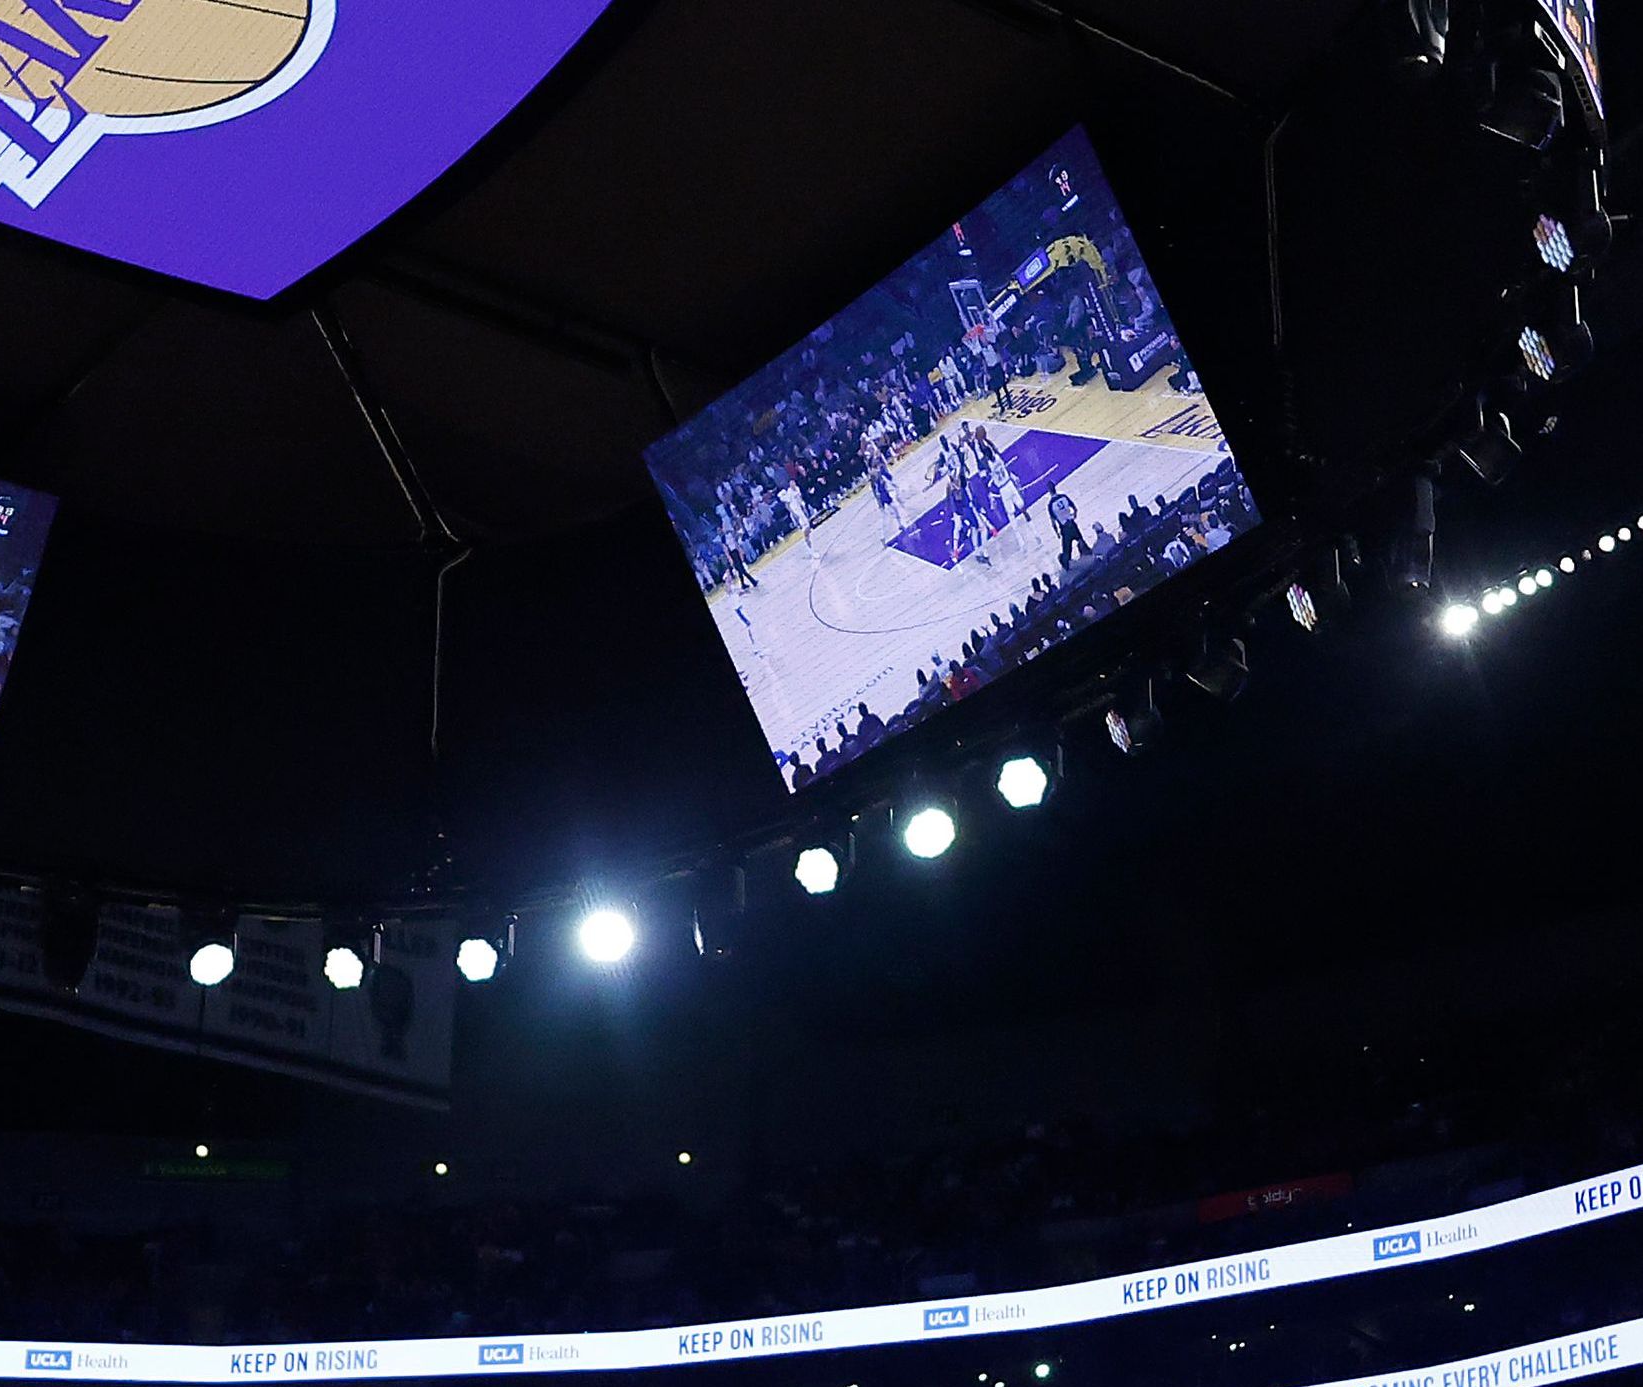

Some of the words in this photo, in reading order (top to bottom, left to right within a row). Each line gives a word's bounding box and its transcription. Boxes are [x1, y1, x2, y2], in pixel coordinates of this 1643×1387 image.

[1575, 1182, 1622, 1215] KEEP
[1377, 1236, 1416, 1256] UCLA
[1427, 1224, 1478, 1249] Health
[1122, 1278, 1168, 1304] KEEP
[1175, 1271, 1200, 1295] ON
[1207, 1259, 1270, 1290] RISING
[928, 1310, 965, 1327] UCLA
[975, 1303, 1026, 1322] Health
[483, 1346, 520, 1362] UCLA
[529, 1344, 580, 1361] Health
[679, 1333, 723, 1356] KEEP
[730, 1330, 754, 1351] ON
[761, 1320, 824, 1346] RISING
[29, 1352, 68, 1369] UCLA
[78, 1353, 129, 1370] Health
[230, 1353, 277, 1374] KEEP
[283, 1351, 309, 1372] ON
[315, 1349, 378, 1371] RISING
[1508, 1335, 1619, 1382] CHALLENGE
